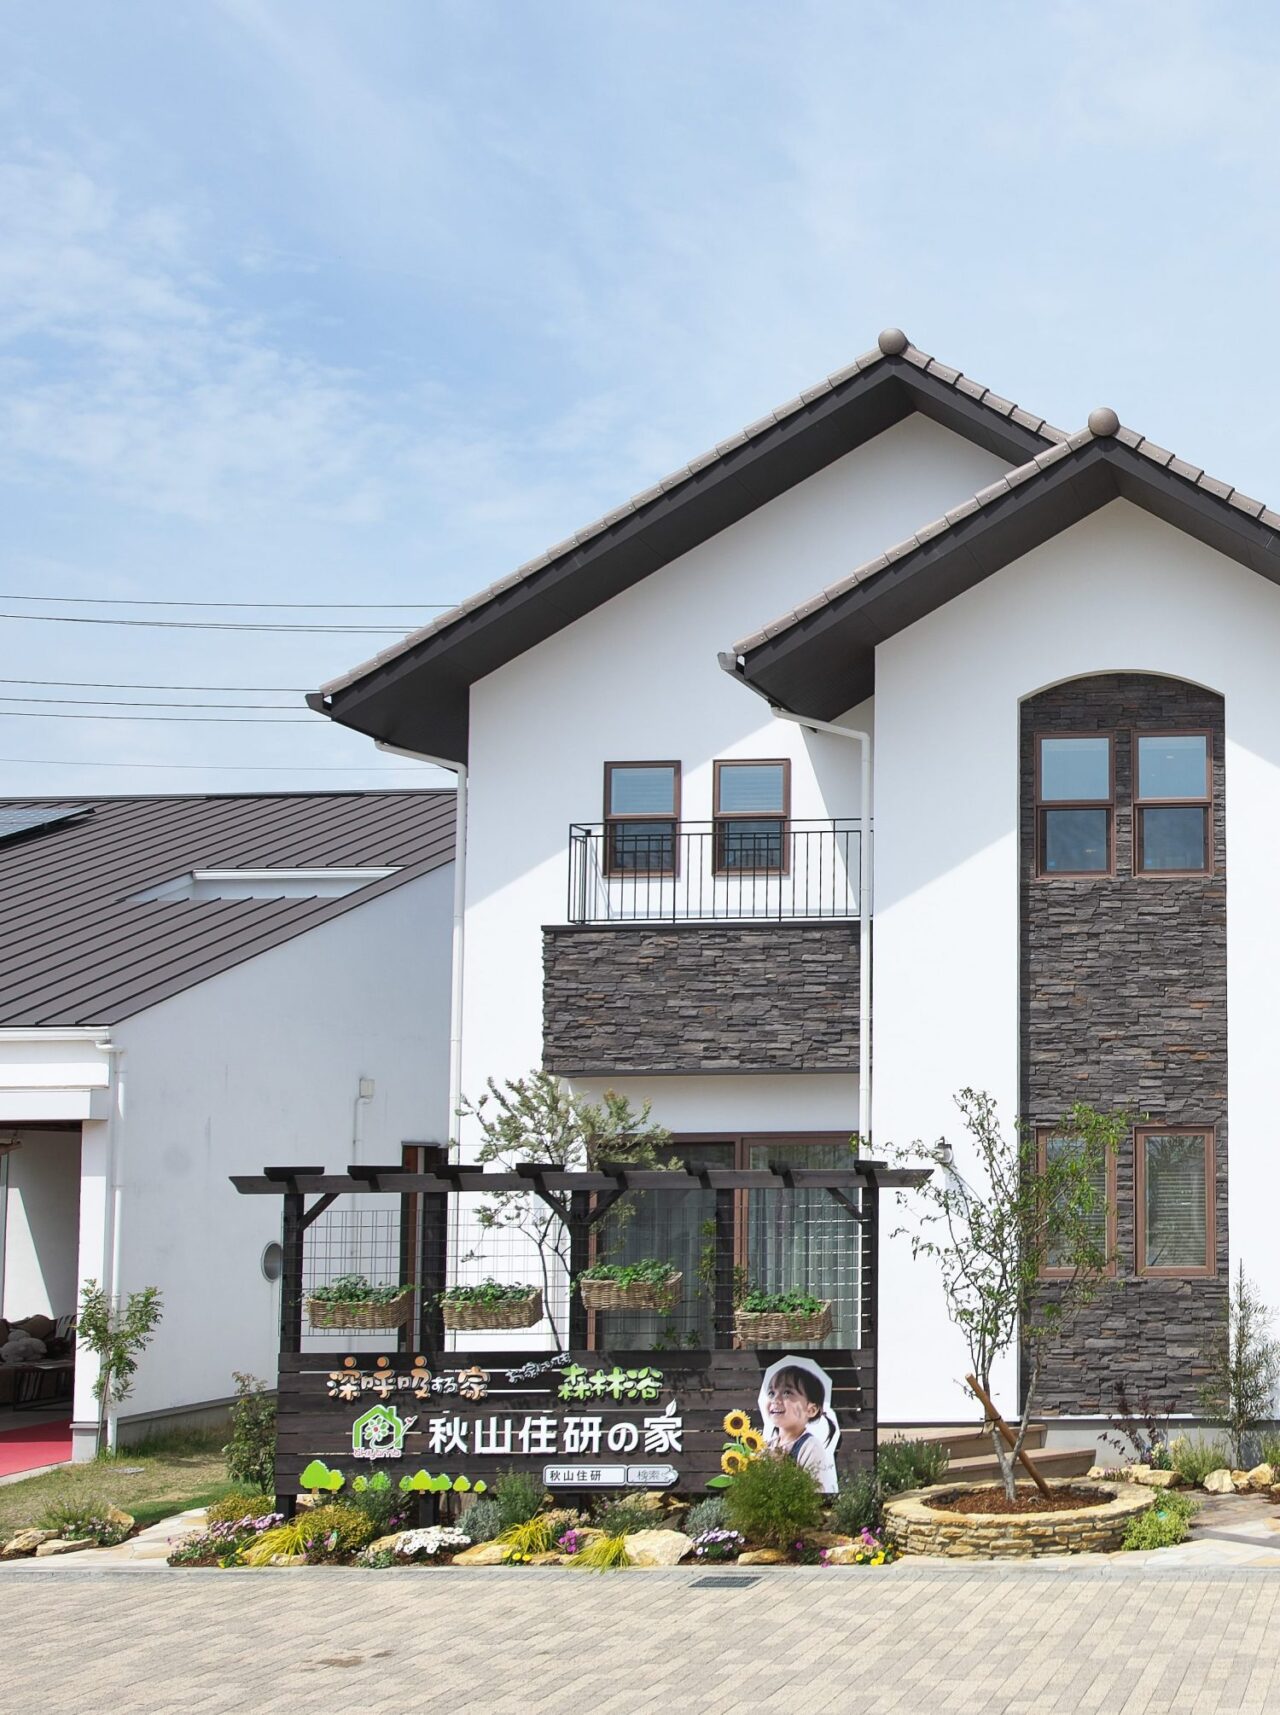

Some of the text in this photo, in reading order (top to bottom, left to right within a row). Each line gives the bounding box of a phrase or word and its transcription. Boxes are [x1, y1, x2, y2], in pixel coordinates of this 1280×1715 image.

[326, 1356, 491, 1400] 深呼吸する家
[557, 1363, 663, 1400] 森林浴
[428, 1416, 682, 1454] 秋山住研の家
[549, 1469, 602, 1482] 秋山住研
